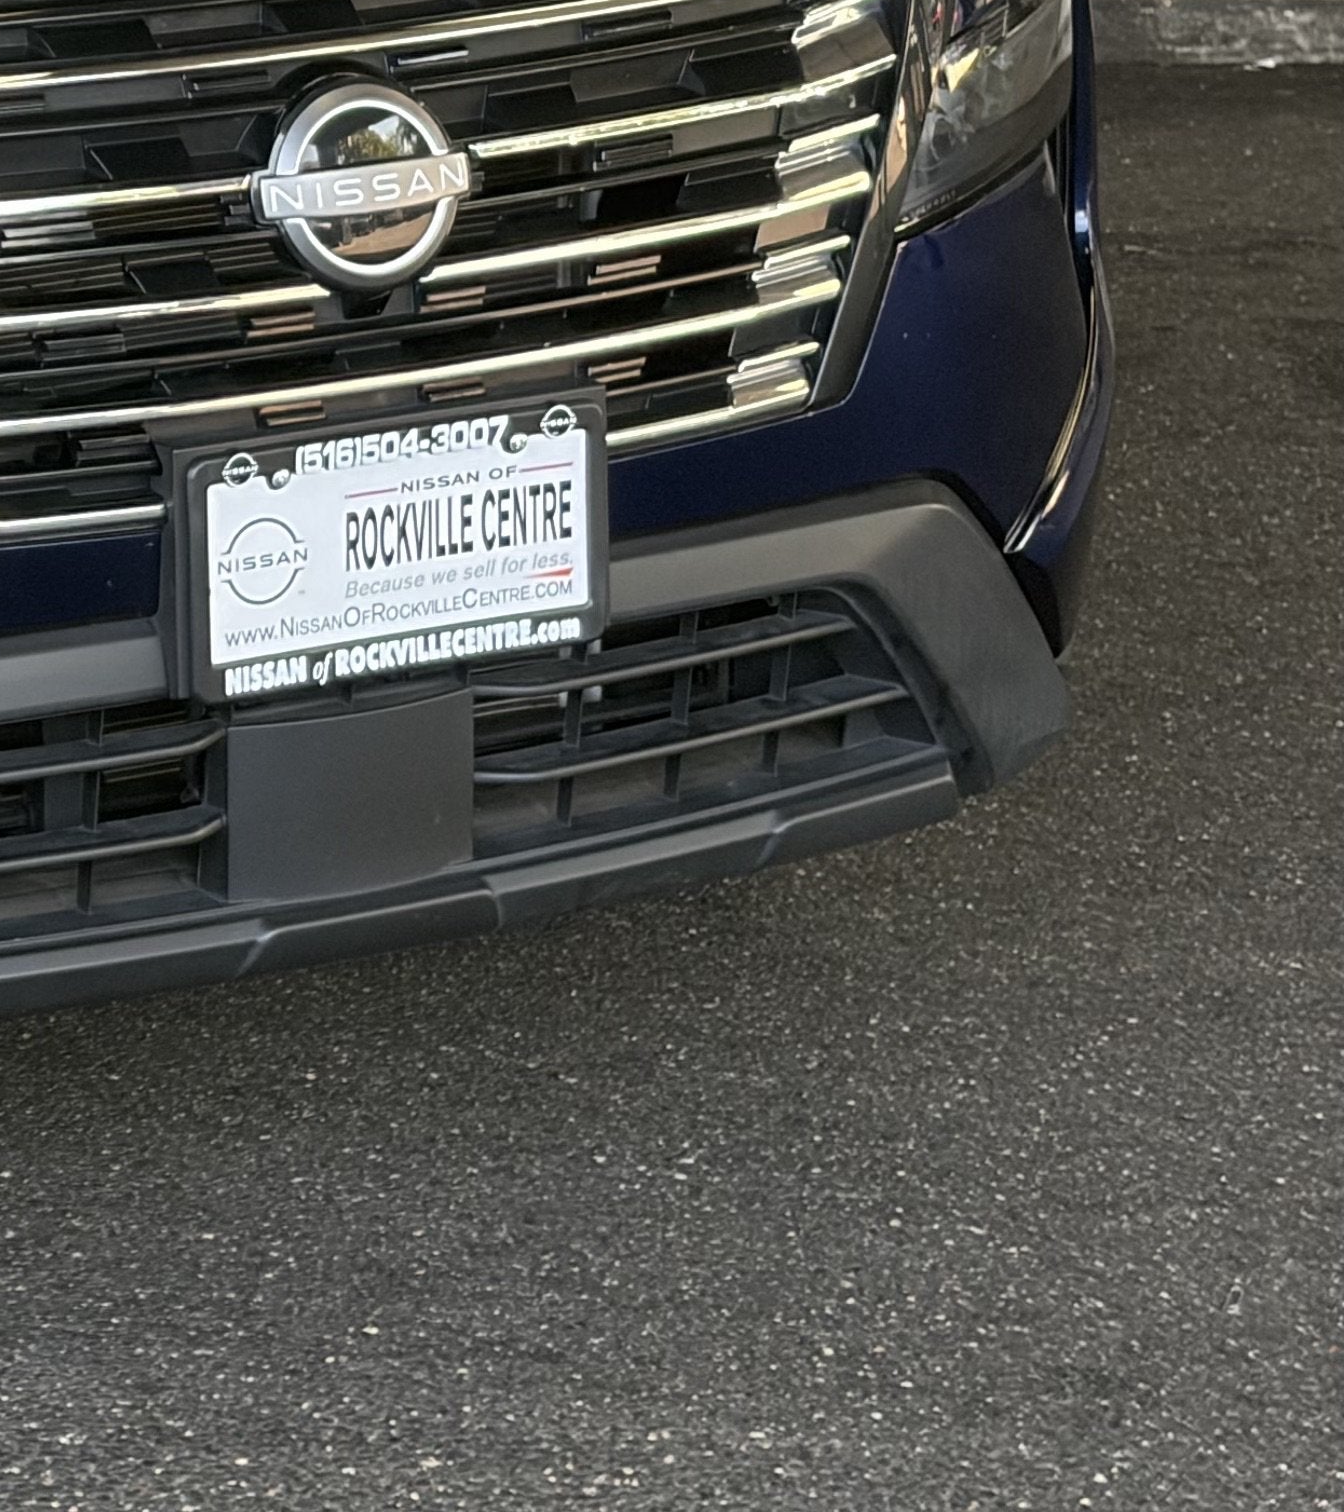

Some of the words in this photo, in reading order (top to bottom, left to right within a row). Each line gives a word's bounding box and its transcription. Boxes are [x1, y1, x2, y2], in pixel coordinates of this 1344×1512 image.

[269, 159, 467, 213] NISSAN
[295, 414, 509, 475] (516)504-3007
[401, 471, 480, 494] NISSAN
[489, 465, 519, 481] OF
[345, 491, 474, 573] ROCKVILLE
[481, 479, 574, 551] CENTRE
[217, 546, 309, 576] NISSAN
[345, 572, 425, 599] Because
[431, 568, 458, 585] we
[463, 559, 496, 582] sell
[500, 554, 529, 576] for
[531, 550, 574, 572] less.
[224, 654, 308, 697] NISSAN
[312, 655, 334, 687] of
[334, 617, 582, 677] ROCKVILLECENTRE.com
